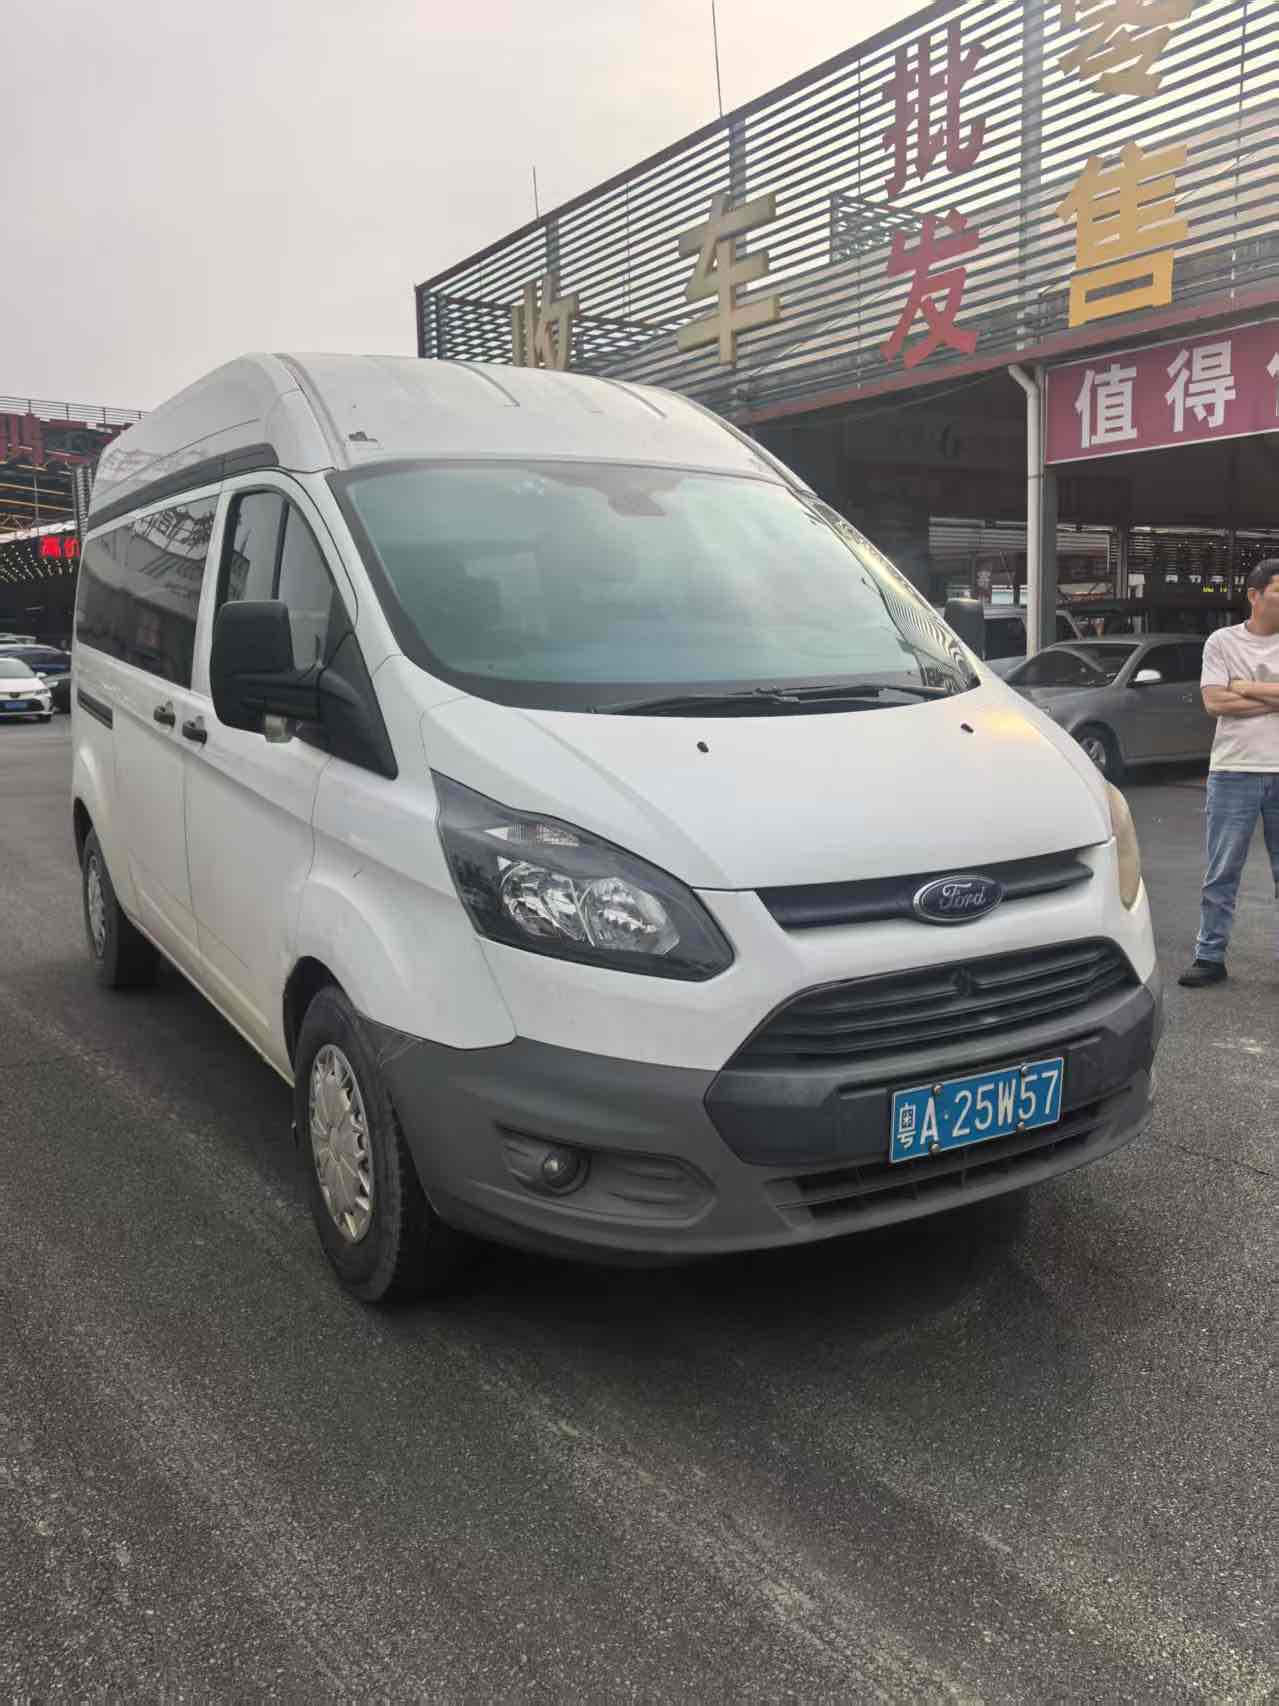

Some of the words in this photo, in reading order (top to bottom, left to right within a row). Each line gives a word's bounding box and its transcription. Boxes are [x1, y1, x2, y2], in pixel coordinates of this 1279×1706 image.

[880, 19, 985, 368] 批发
[1074, 339, 1279, 449] 值得
[939, 882, 987, 911] Ford
